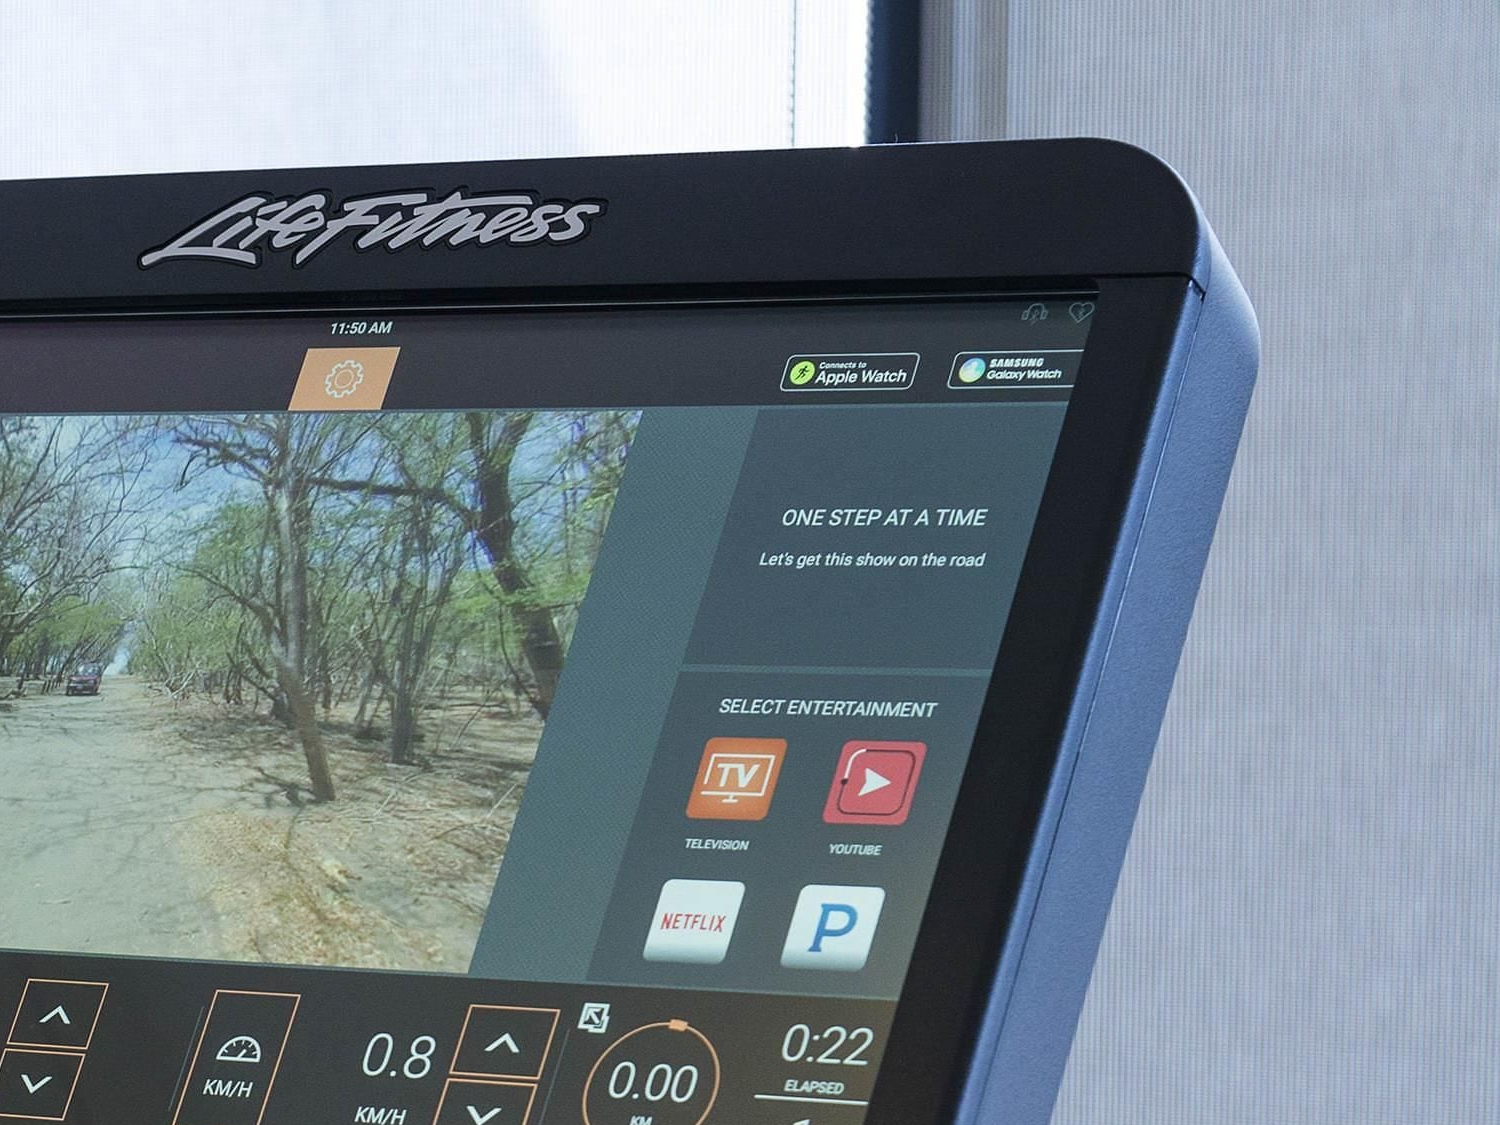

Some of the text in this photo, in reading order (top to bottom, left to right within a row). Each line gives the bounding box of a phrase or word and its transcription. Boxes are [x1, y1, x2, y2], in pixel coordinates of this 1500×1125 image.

[330, 320, 393, 336] 11:50 AM
[819, 361, 867, 370] Connects to
[989, 358, 1045, 368] SAMSUNG
[814, 369, 908, 386] Apple Watch
[986, 369, 1063, 382] Galaxy Watch
[781, 509, 989, 526] ONE STEP AT A TIME
[759, 552, 986, 570] Let's get this show on the road
[719, 698, 938, 718] SELECT ENTERTAINMENT
[716, 763, 760, 788] TV
[685, 838, 750, 851] TELEVISION
[829, 843, 883, 856] YOUTUBE
[660, 913, 726, 933] NETFLIX
[807, 903, 859, 953] P
[781, 1023, 876, 1067] 0:22
[361, 1032, 437, 1080] 0.8
[202, 1078, 253, 1099] KM/H
[608, 1061, 699, 1103] 0.00
[784, 1078, 845, 1096] ELAPSED
